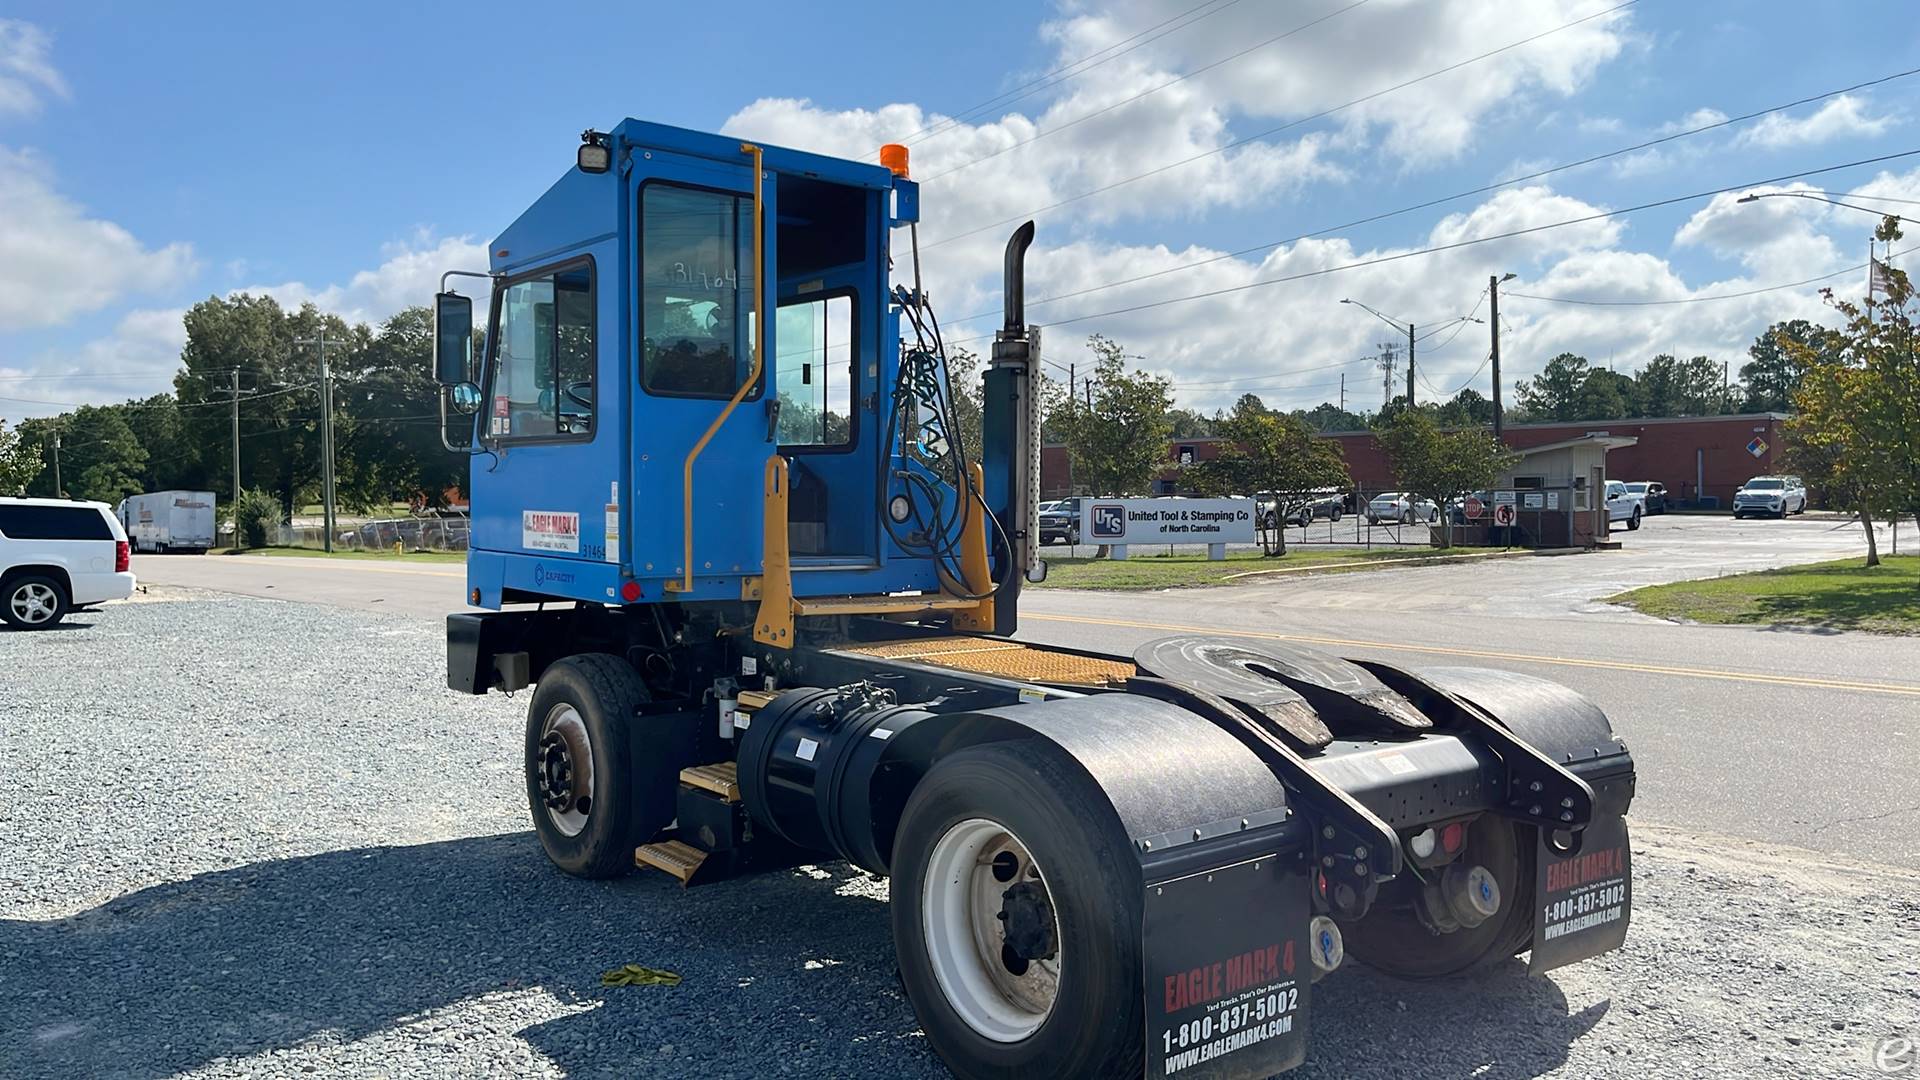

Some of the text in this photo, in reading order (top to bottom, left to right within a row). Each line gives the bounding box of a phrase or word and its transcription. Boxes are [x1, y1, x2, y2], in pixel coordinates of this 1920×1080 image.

[1096, 509, 1122, 534] UTS
[1128, 510, 1249, 523] United Tool & Stamping Co
[1465, 503, 1480, 513] STOP
[532, 514, 551, 533] EAGLE
[552, 515, 572, 535] MARK
[572, 516, 578, 536] 4
[1159, 524, 1221, 533] of North Carolina
[1547, 848, 1622, 892] EAGLE MARK 4
[1544, 884, 1625, 923] 1-800-837-5002
[1545, 905, 1621, 941] WWW.EAGLEMARK4.COM
[1165, 939, 1296, 1013] EAGLE MARK 4
[1206, 1002, 1220, 1012] Yard
[1240, 990, 1256, 1001] That's
[1256, 987, 1267, 995] Our
[1162, 987, 1298, 1053] 1-800-837-5002
[1165, 1015, 1293, 1076] WWW.EAGLEMARK4.COM
